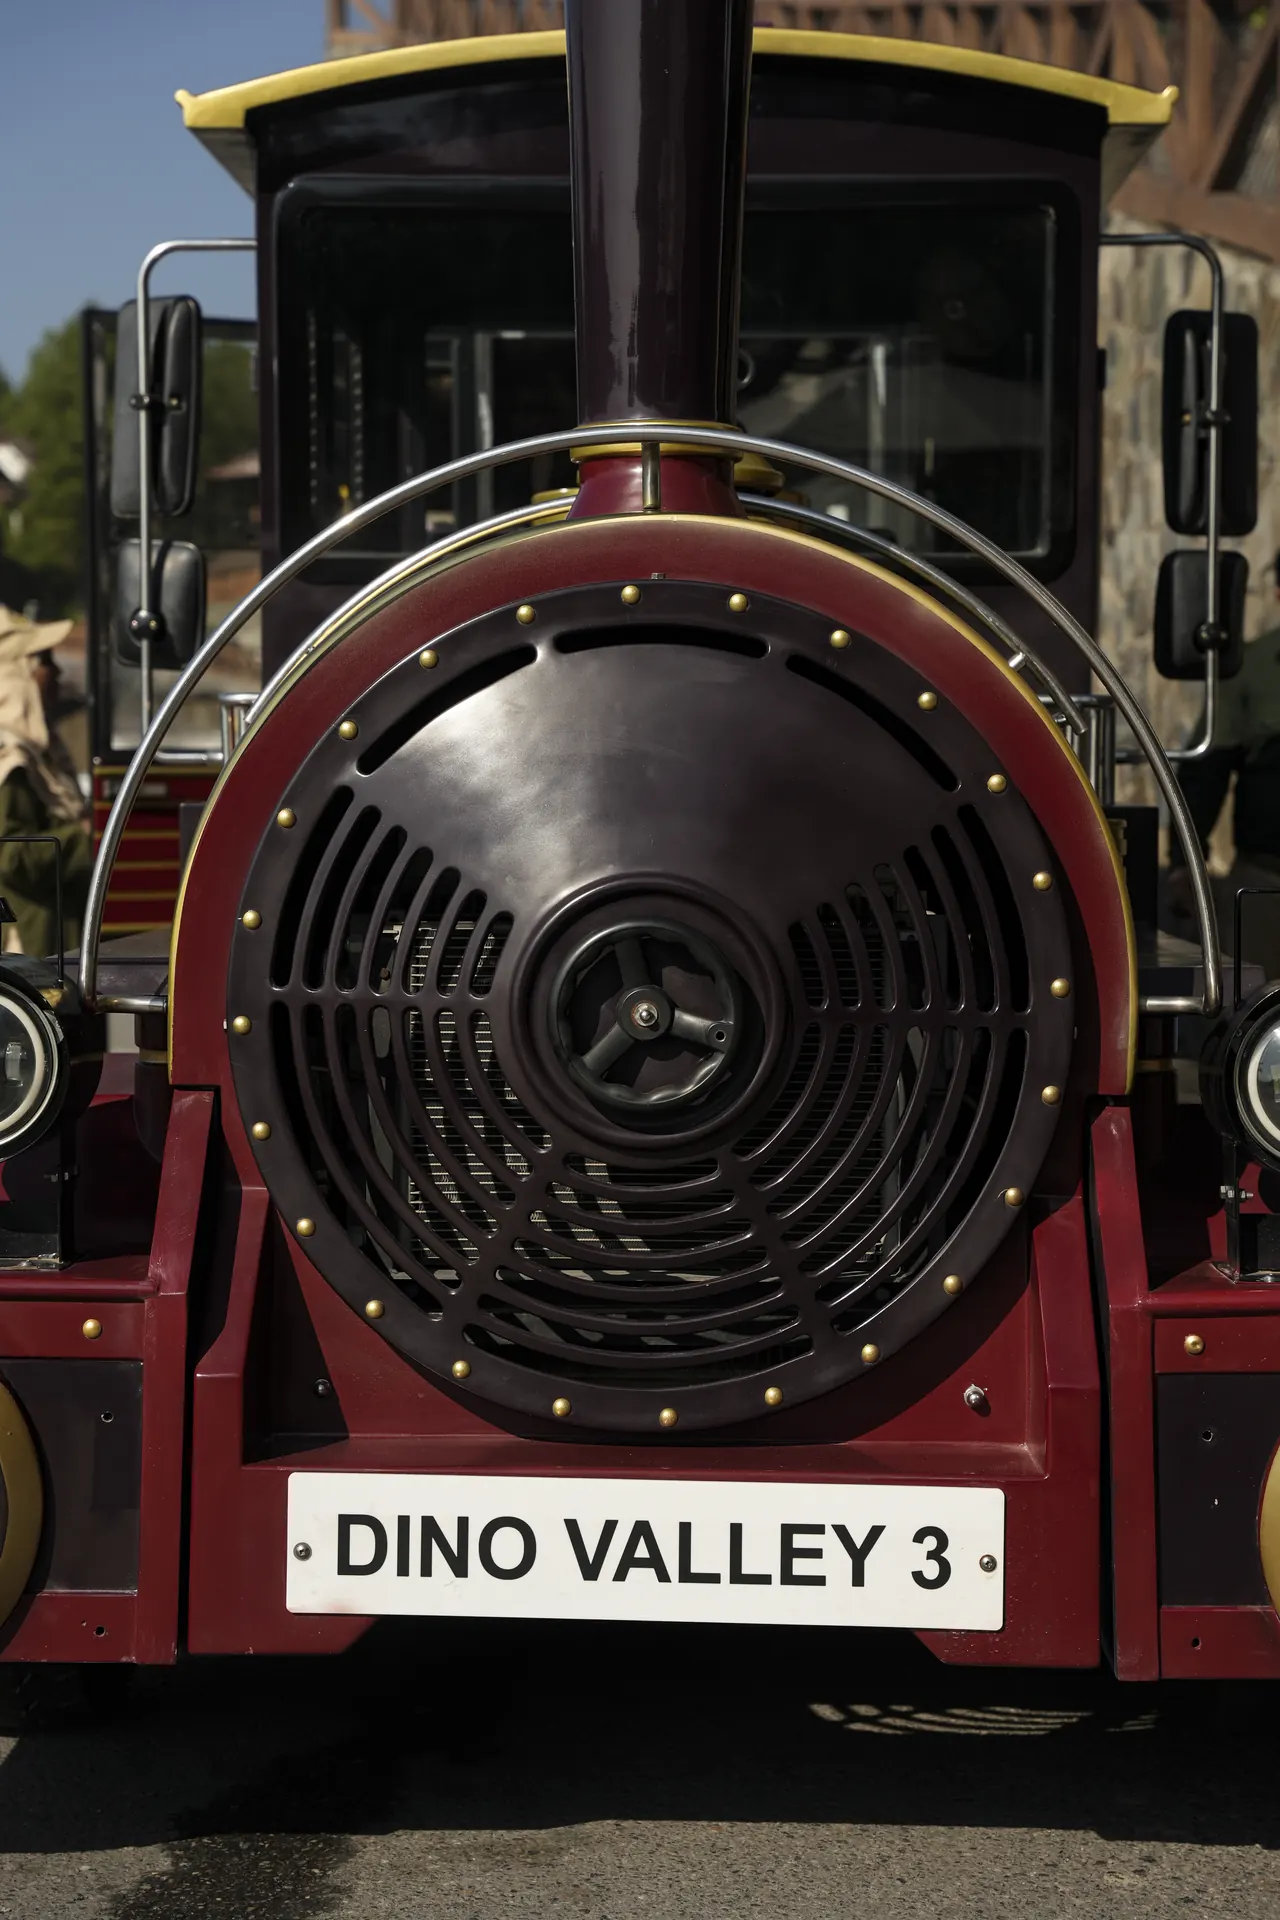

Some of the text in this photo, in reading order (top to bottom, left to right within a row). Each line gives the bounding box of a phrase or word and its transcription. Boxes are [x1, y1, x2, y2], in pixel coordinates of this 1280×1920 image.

[338, 1514, 952, 1590] DINO VALLEY 3
